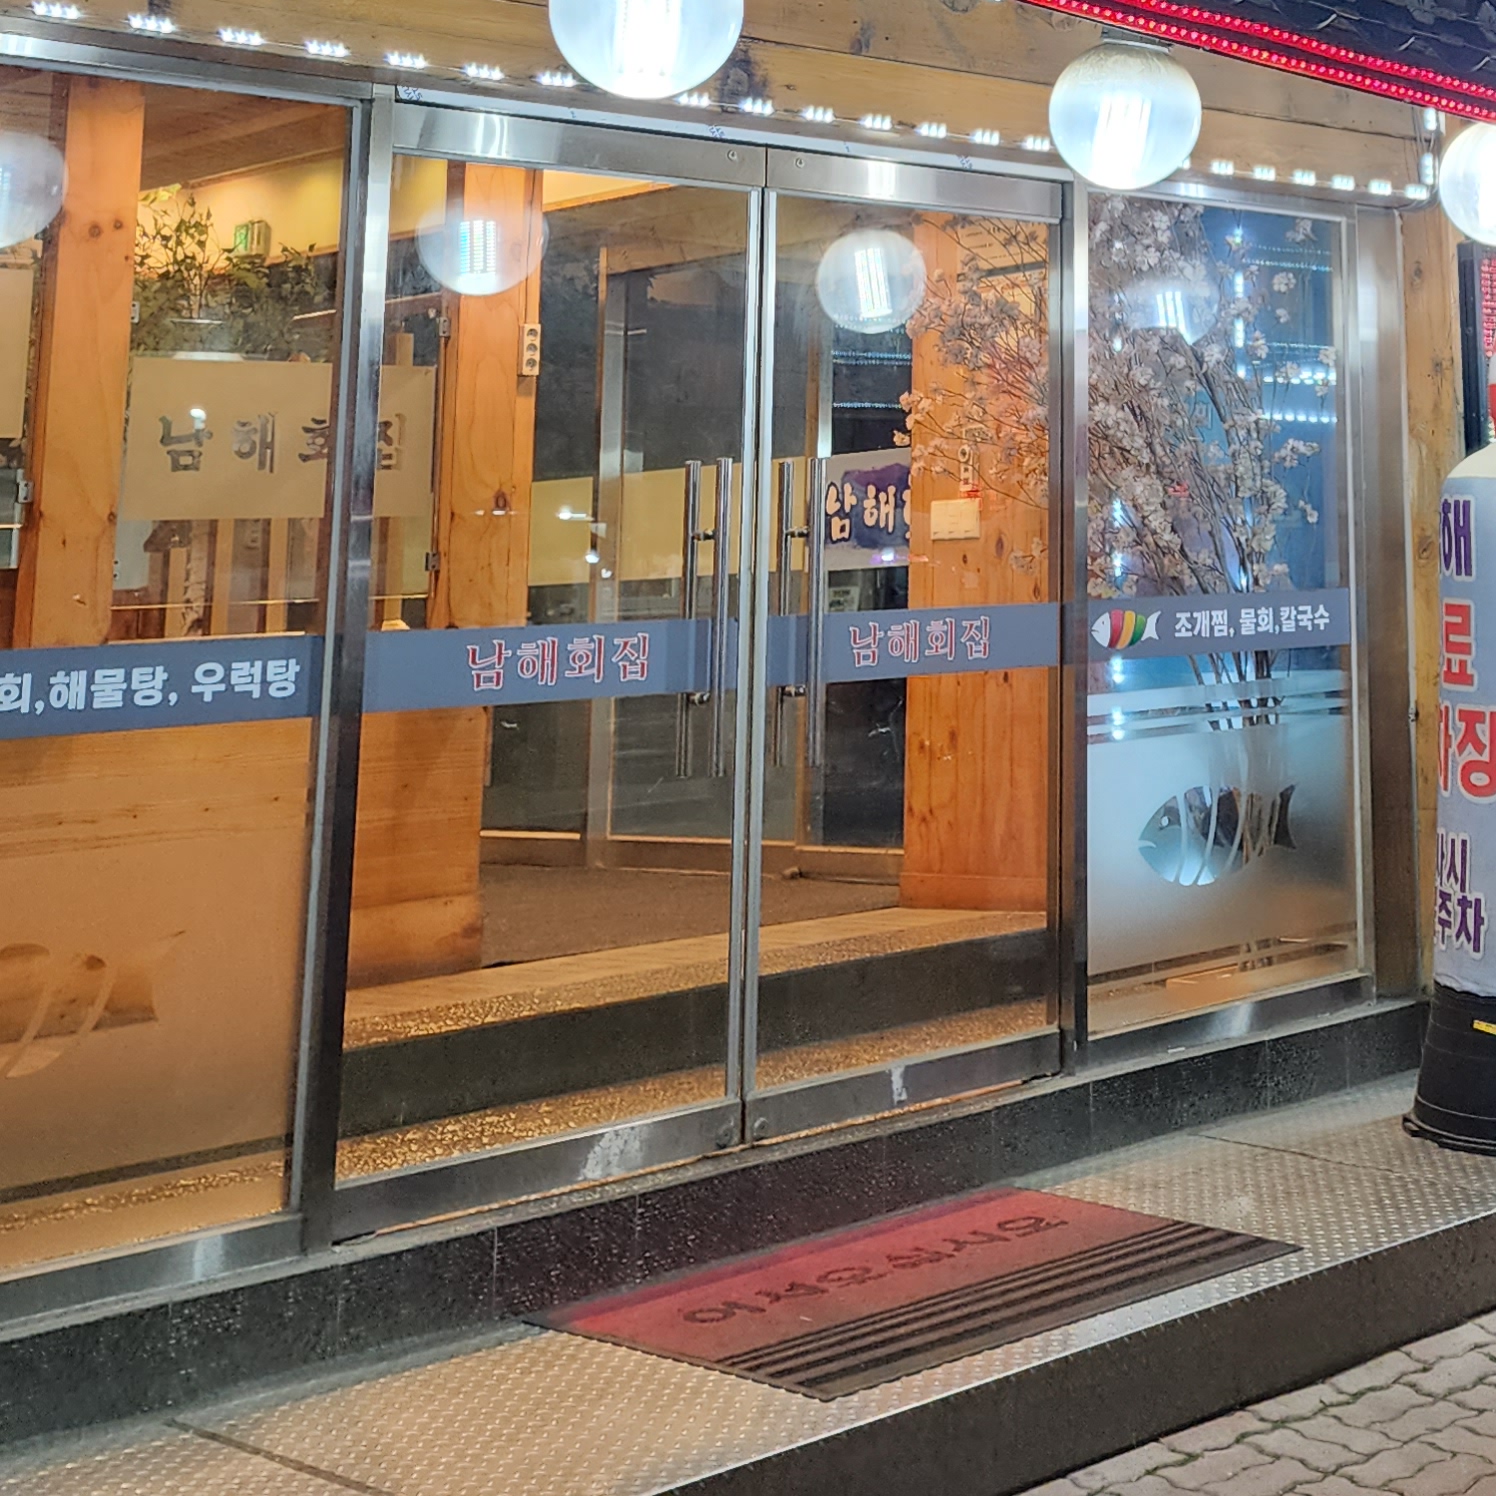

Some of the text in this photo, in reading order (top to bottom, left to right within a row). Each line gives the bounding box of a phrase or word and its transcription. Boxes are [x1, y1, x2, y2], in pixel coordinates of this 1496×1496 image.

[825, 474, 911, 544] 남해
[849, 615, 991, 668] 남해회집
[1173, 608, 1235, 639] 조개찜,
[190, 657, 301, 703] 우럭탕
[466, 632, 649, 692] 남해회집
